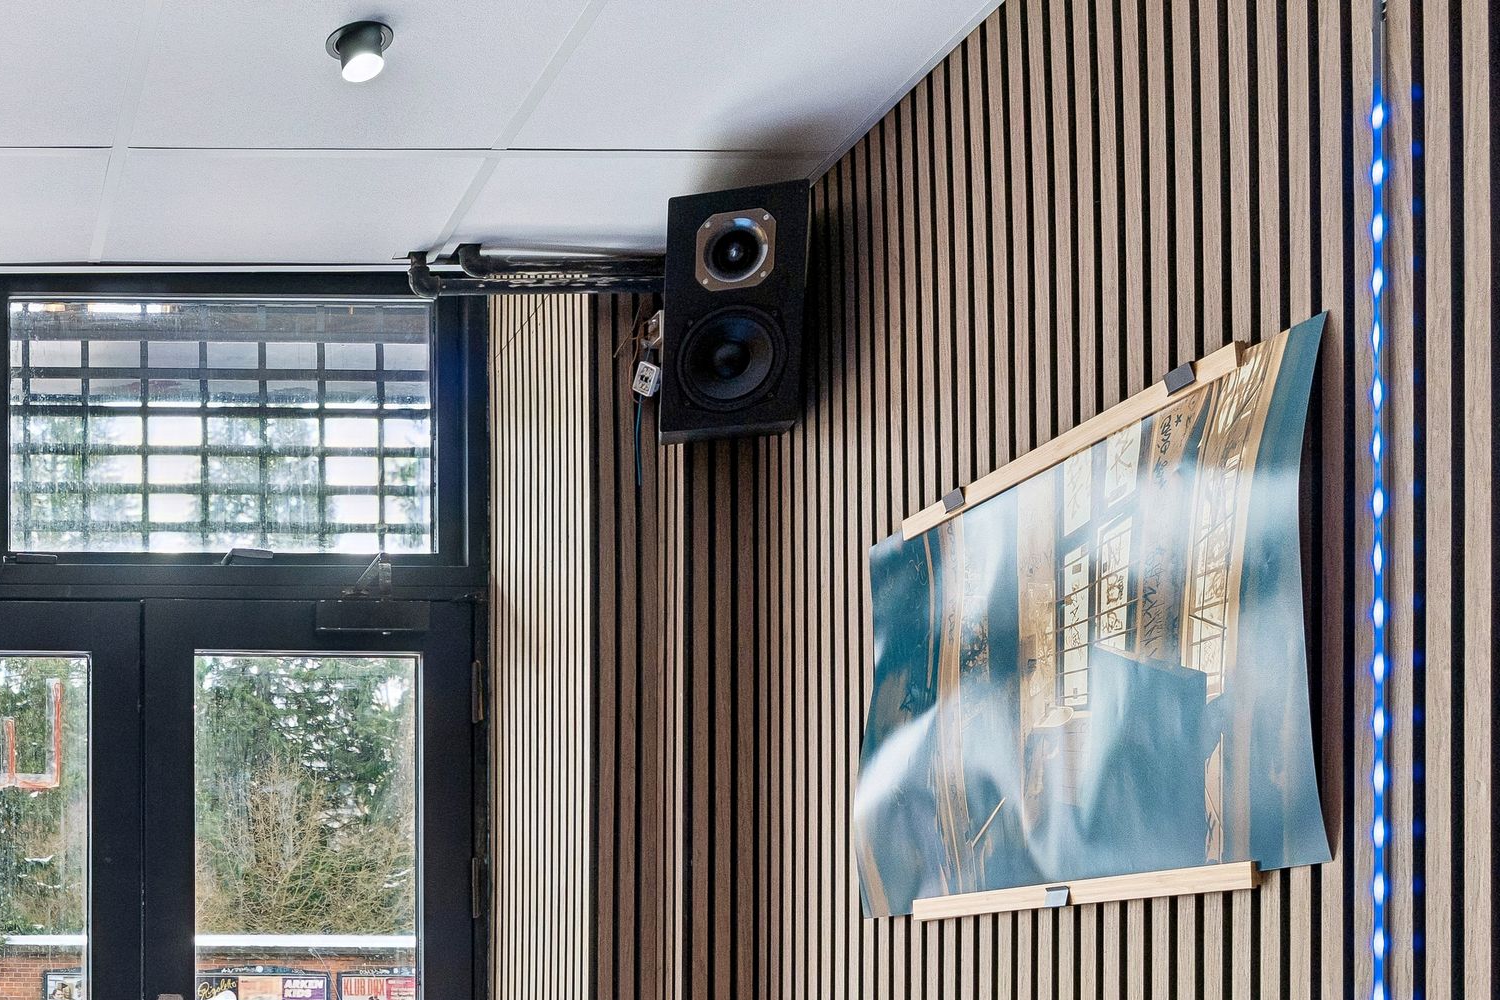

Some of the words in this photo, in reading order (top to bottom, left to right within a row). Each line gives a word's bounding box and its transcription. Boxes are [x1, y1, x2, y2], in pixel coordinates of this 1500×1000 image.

[283, 980, 324, 989] ARKEN
[343, 978, 366, 996] KLUB
[283, 988, 312, 998] KIDS
